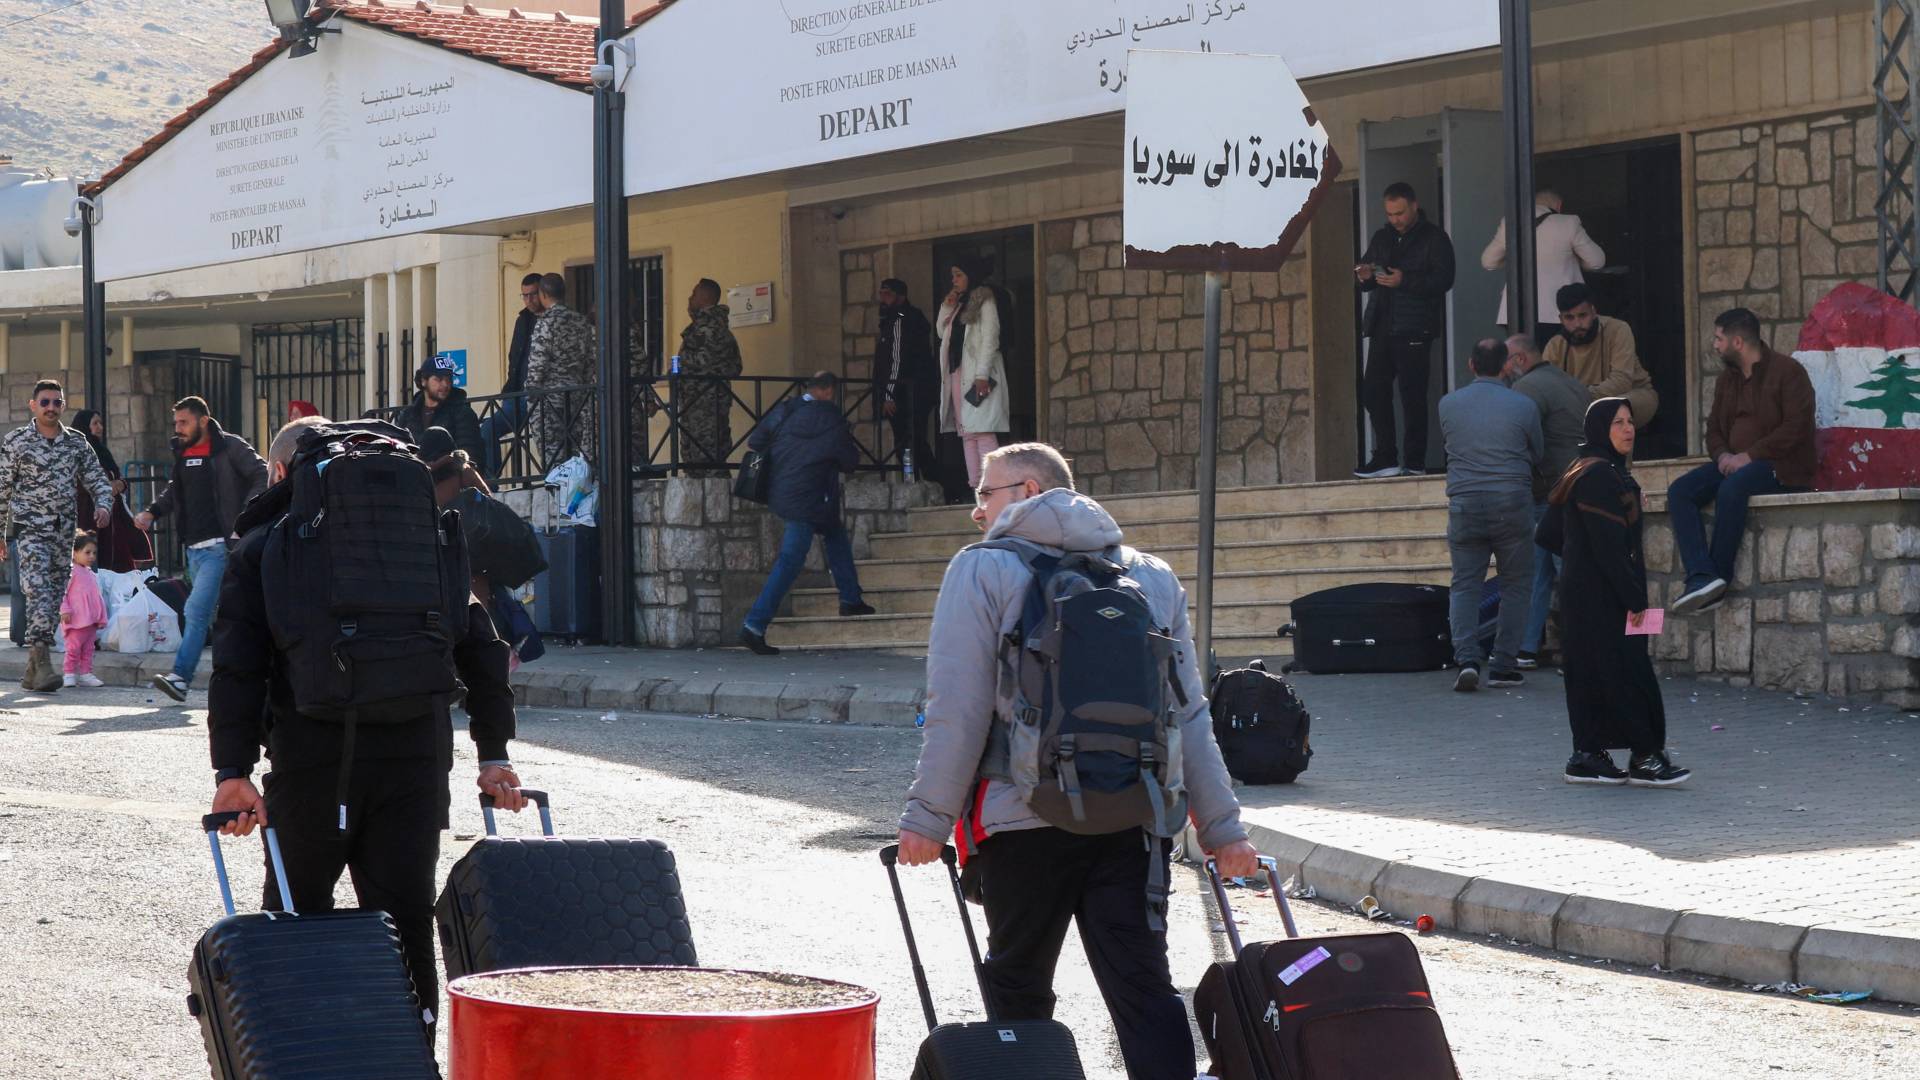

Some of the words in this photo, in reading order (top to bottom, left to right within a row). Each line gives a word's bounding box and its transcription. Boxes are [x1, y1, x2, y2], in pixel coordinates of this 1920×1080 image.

[791, 8, 847, 33] DIRECTION
[849, 0, 907, 20] GENERALE
[1131, 3, 1195, 42] المصنع
[1201, 0, 1246, 25] مركز
[816, 36, 856, 57] SURETE
[858, 23, 917, 48] GENERALE
[1066, 17, 1126, 54] الحدودي
[407, 76, 455, 97] الجمهورية
[780, 82, 814, 102] POSTE
[816, 68, 884, 96] FRONTALIER
[888, 65, 903, 81] DE
[906, 55, 957, 78] MASNAA
[361, 86, 405, 106] اللبنانية
[210, 115, 260, 136] REPUBLIQUE
[261, 106, 304, 126] LIBANAISE
[819, 98, 912, 141] DEPART
[216, 137, 249, 152] MINISTERE
[250, 135, 259, 146] DE
[216, 164, 247, 178] DIRECTION
[248, 157, 280, 172] GENERALE
[281, 155, 289, 167] DE
[290, 154, 298, 165] LA
[387, 153, 404, 172] العام
[1132, 135, 1196, 186] سوريا
[1204, 138, 1240, 188] الى
[230, 182, 252, 194] SURETE
[253, 175, 285, 191] GENERALE
[363, 180, 394, 203] الحدودي
[396, 176, 428, 197] المصنع
[432, 173, 454, 189] مركز
[210, 211, 229, 223] POSTE
[230, 203, 267, 219] FRONTALIER
[269, 201, 278, 213] DE
[279, 197, 306, 211] MASNAA
[380, 199, 437, 228] المغادرة
[232, 225, 283, 249] DEPART
